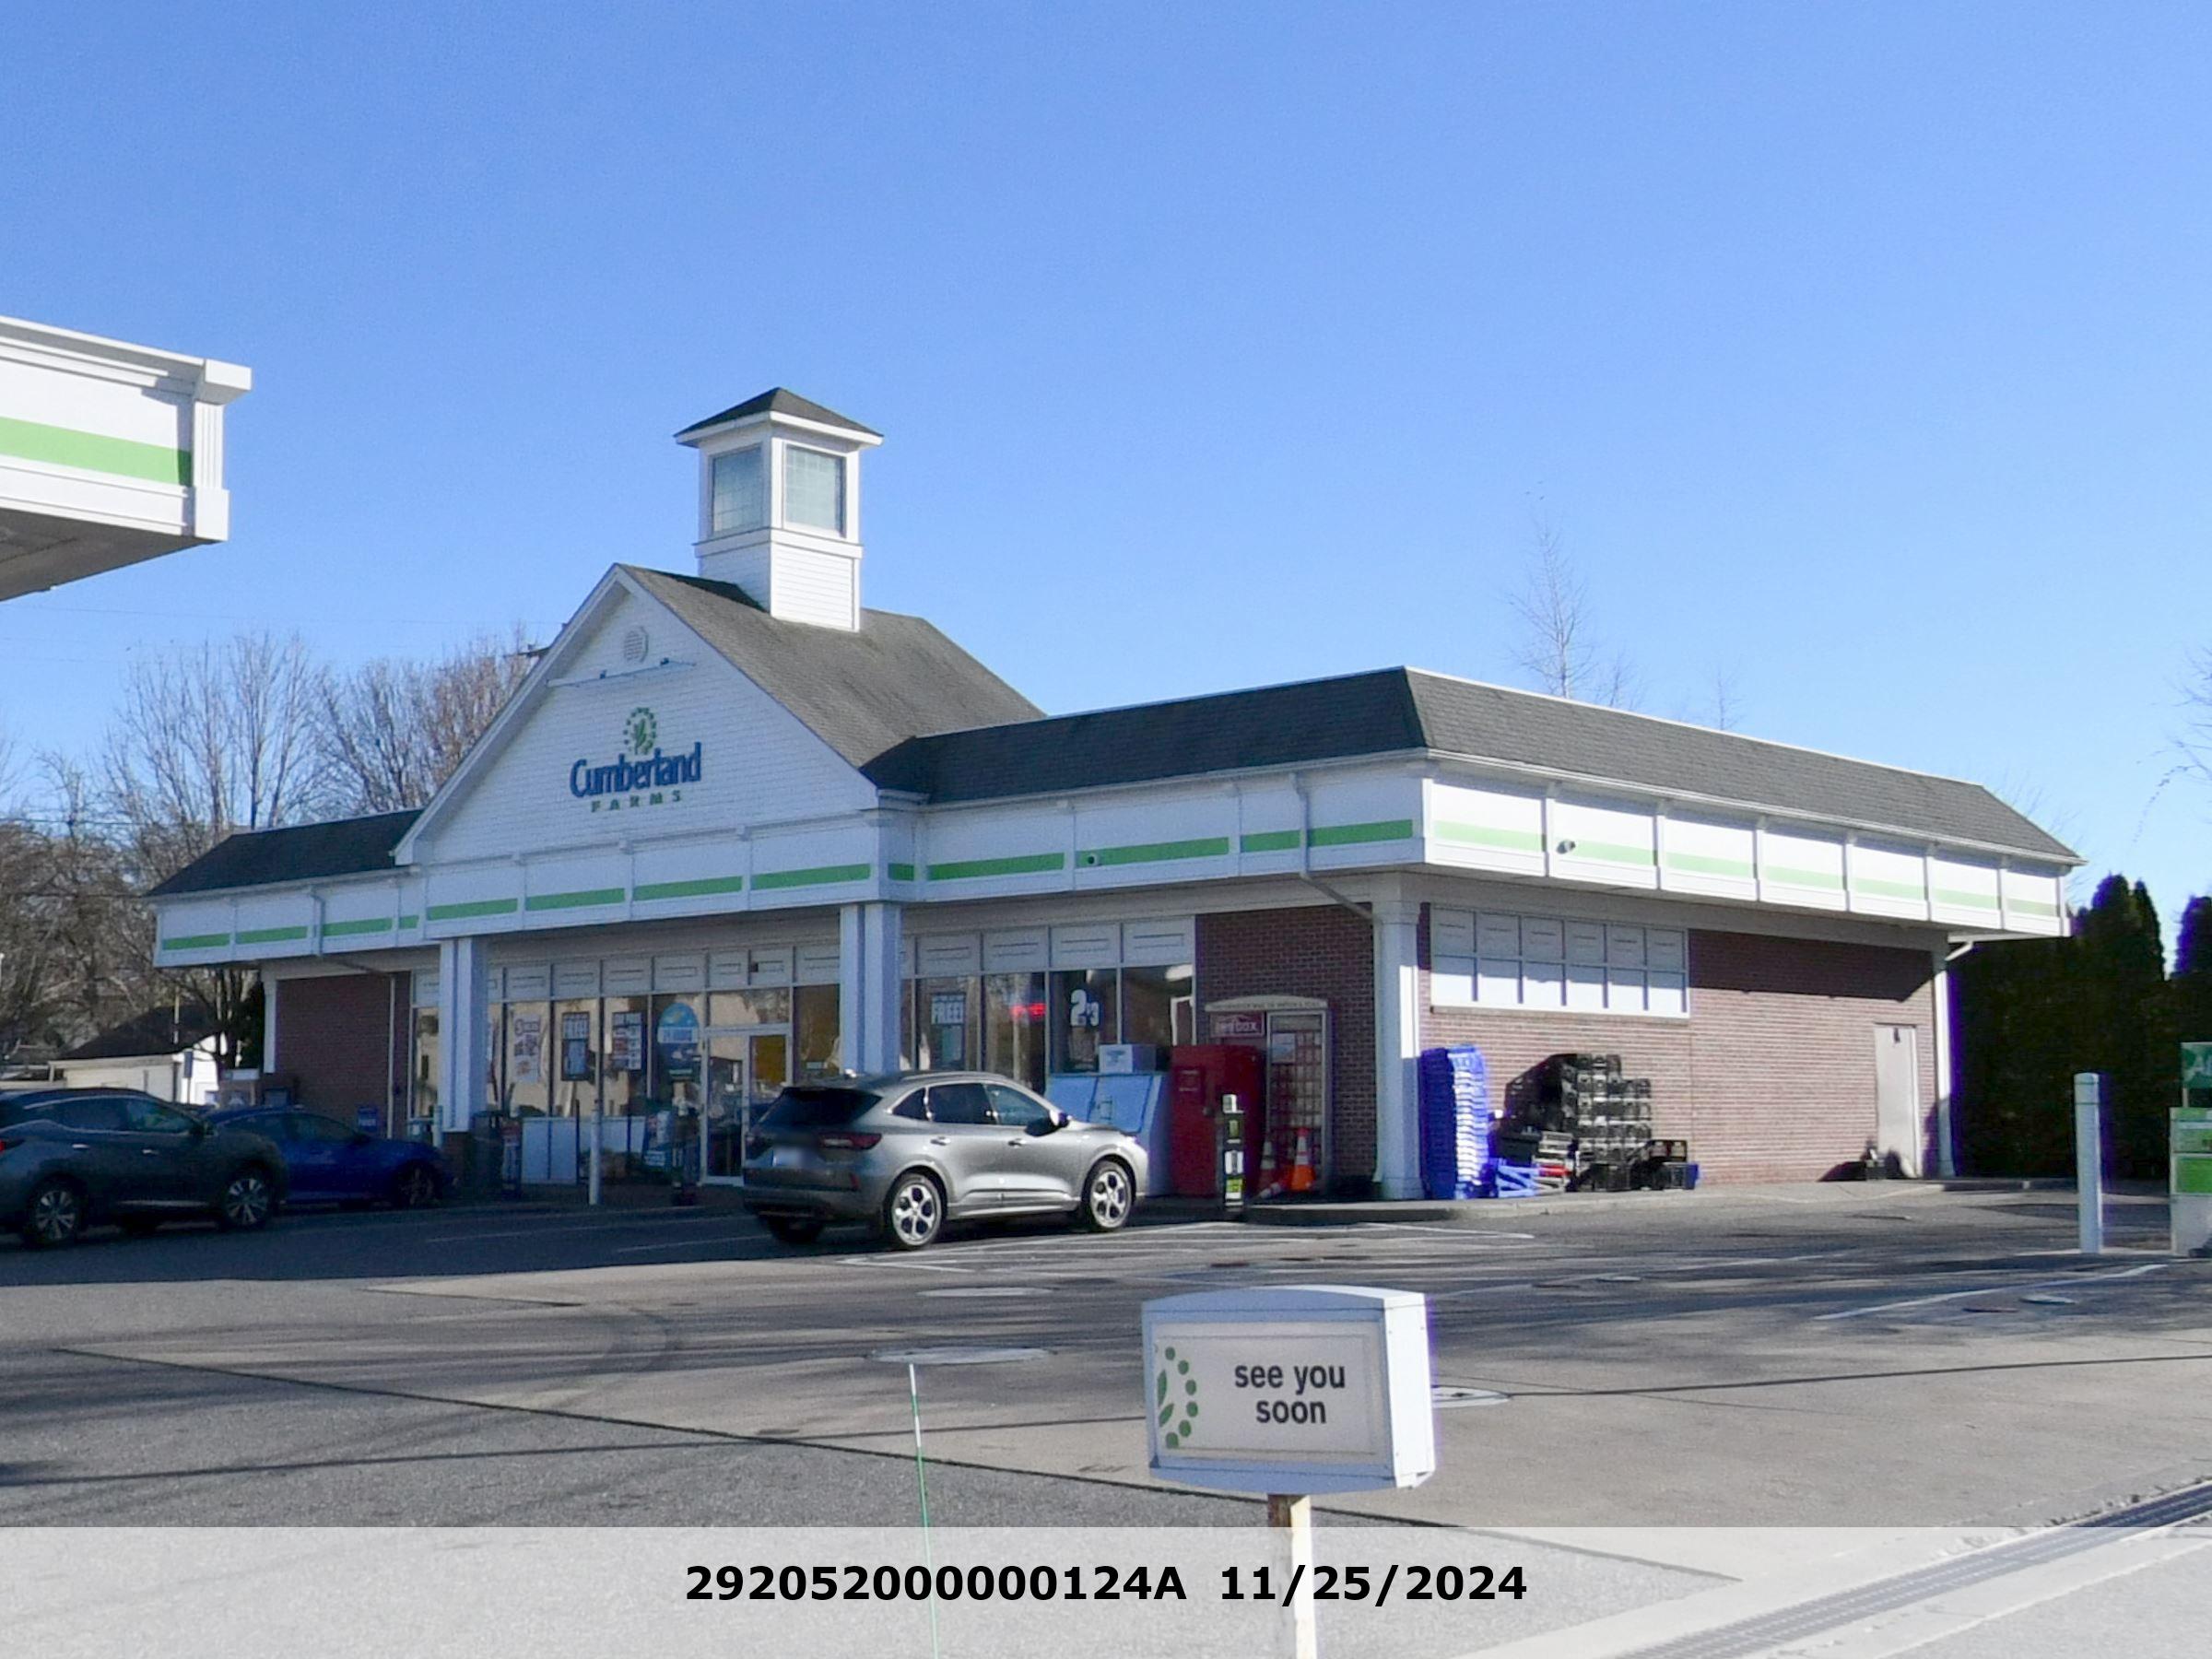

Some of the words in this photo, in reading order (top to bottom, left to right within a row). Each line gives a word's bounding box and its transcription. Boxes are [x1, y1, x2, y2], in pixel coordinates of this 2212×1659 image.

[570, 742, 701, 798] Cumberland
[591, 790, 681, 813] FARMS
[1234, 1365, 1284, 1389] see
[1293, 1365, 1346, 1395] you
[1256, 1400, 1326, 1425] soon
